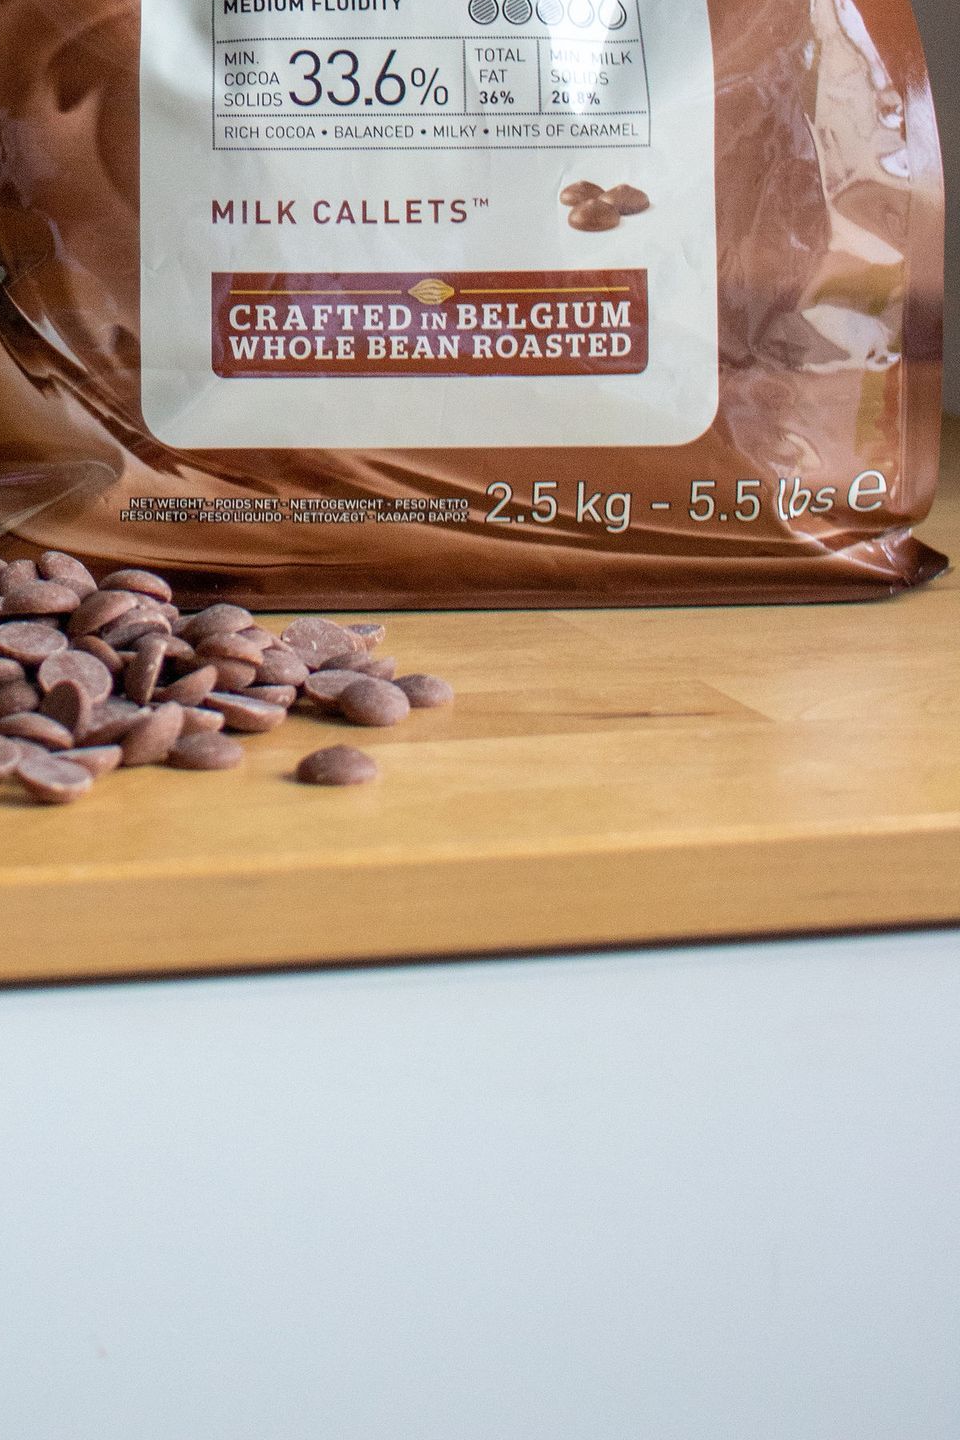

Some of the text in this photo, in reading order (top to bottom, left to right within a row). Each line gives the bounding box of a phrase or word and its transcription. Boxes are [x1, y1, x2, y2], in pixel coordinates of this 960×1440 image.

[224, 51, 260, 66] MIN.
[474, 48, 526, 62] TOTAL
[591, 50, 633, 66] MILK
[224, 71, 281, 87] COCOA
[289, 48, 450, 107] 33.6%
[479, 69, 508, 83] FAT
[550, 69, 609, 86] SOLIDS
[224, 92, 283, 108] SOLIDS
[479, 91, 515, 105] 36%
[224, 123, 639, 140] RICH COCOA BALANCED MILKY HINTS OF CARAMEL
[211, 199, 297, 225] MILK
[229, 301, 631, 331] CRAFTED IN BELGIUM
[229, 333, 632, 361] WHOLE BEAN ROASTED
[130, 498, 469, 510] NET WEIGHT POIDS NET NETTOGEWICHT PESO NETTO
[486, 481, 558, 524] 2.5
[576, 481, 632, 533] kg
[689, 480, 761, 523] 5.5
[778, 477, 837, 522] lbs
[121, 510, 153, 521] PESO
[155, 510, 188, 522] NETO
[199, 511, 231, 522] PESO
[293, 511, 365, 523] NETTOVÆGT
